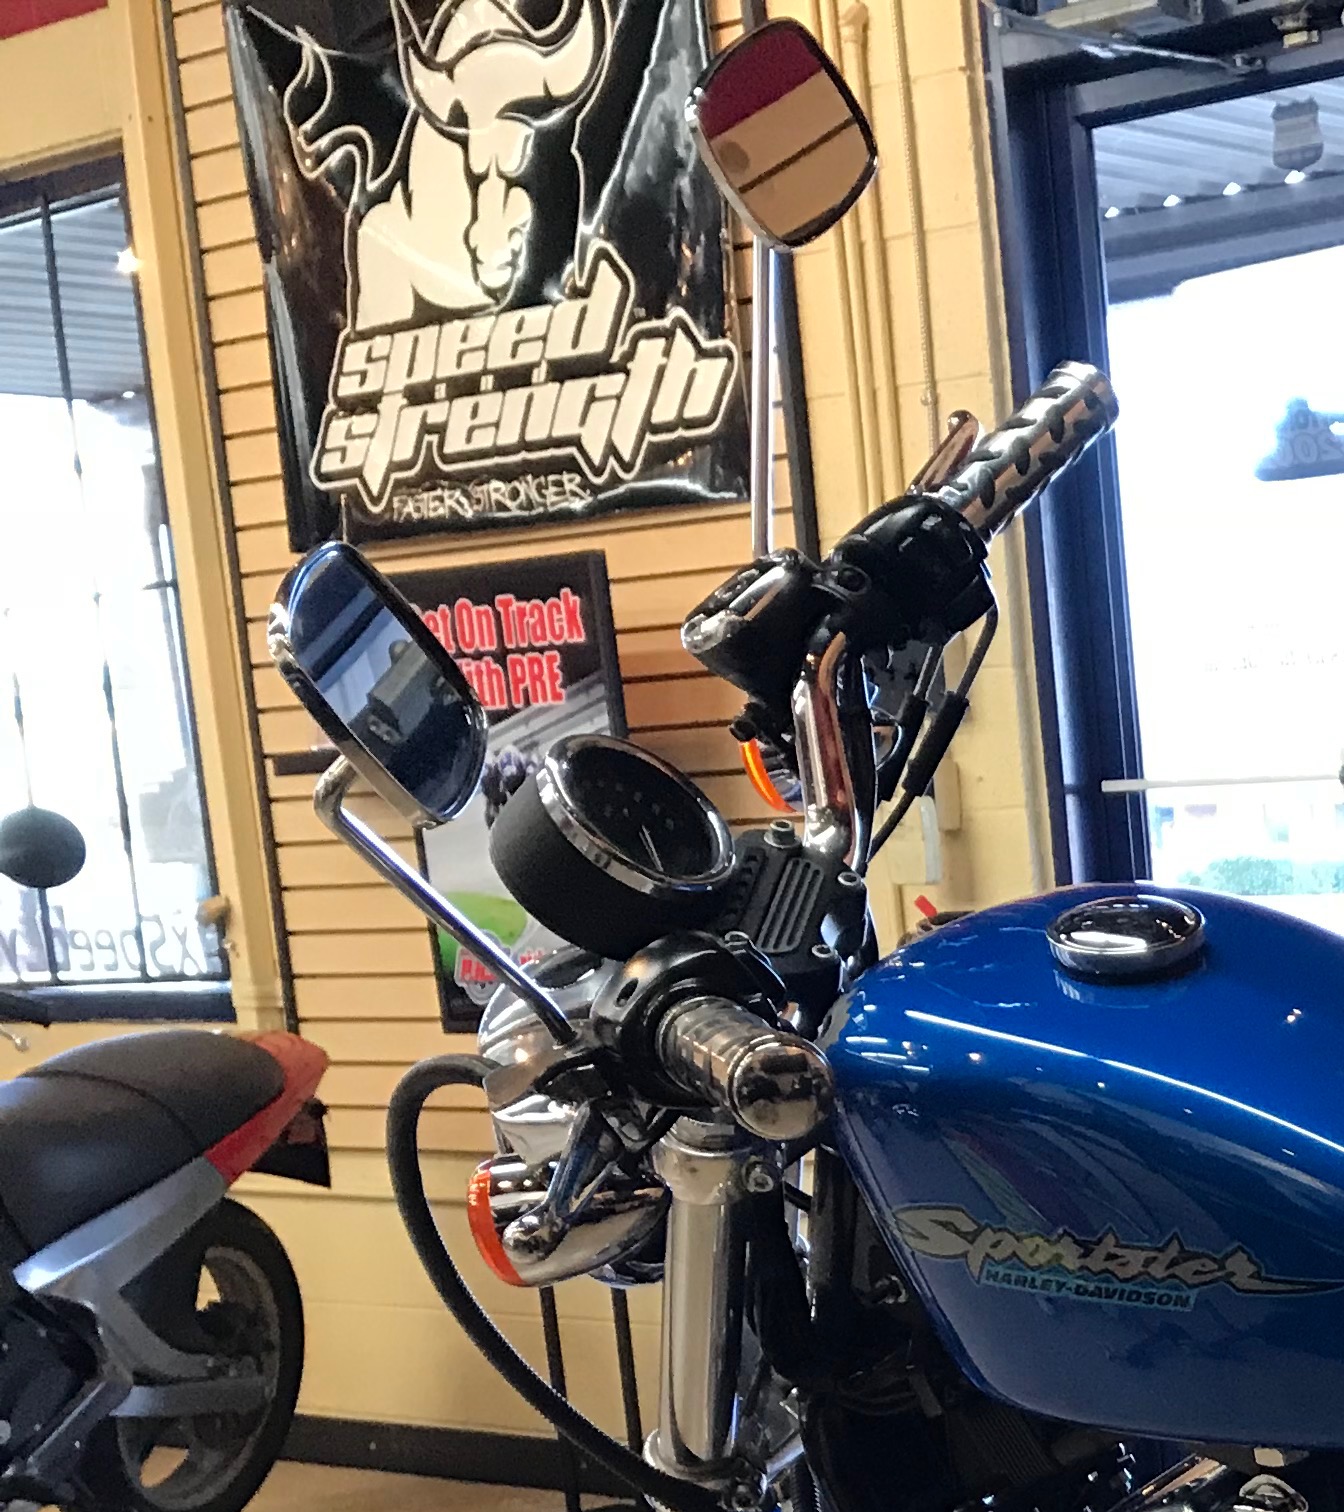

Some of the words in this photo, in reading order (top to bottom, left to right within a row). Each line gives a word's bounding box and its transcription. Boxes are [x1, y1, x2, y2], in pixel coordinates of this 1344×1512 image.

[412, 603, 456, 653] et
[454, 597, 497, 653] On
[495, 586, 586, 649] Track
[454, 655, 509, 710] ith
[507, 650, 566, 708] PRE
[985, 1268, 1191, 1308] HARLEY-DAVIDSON
